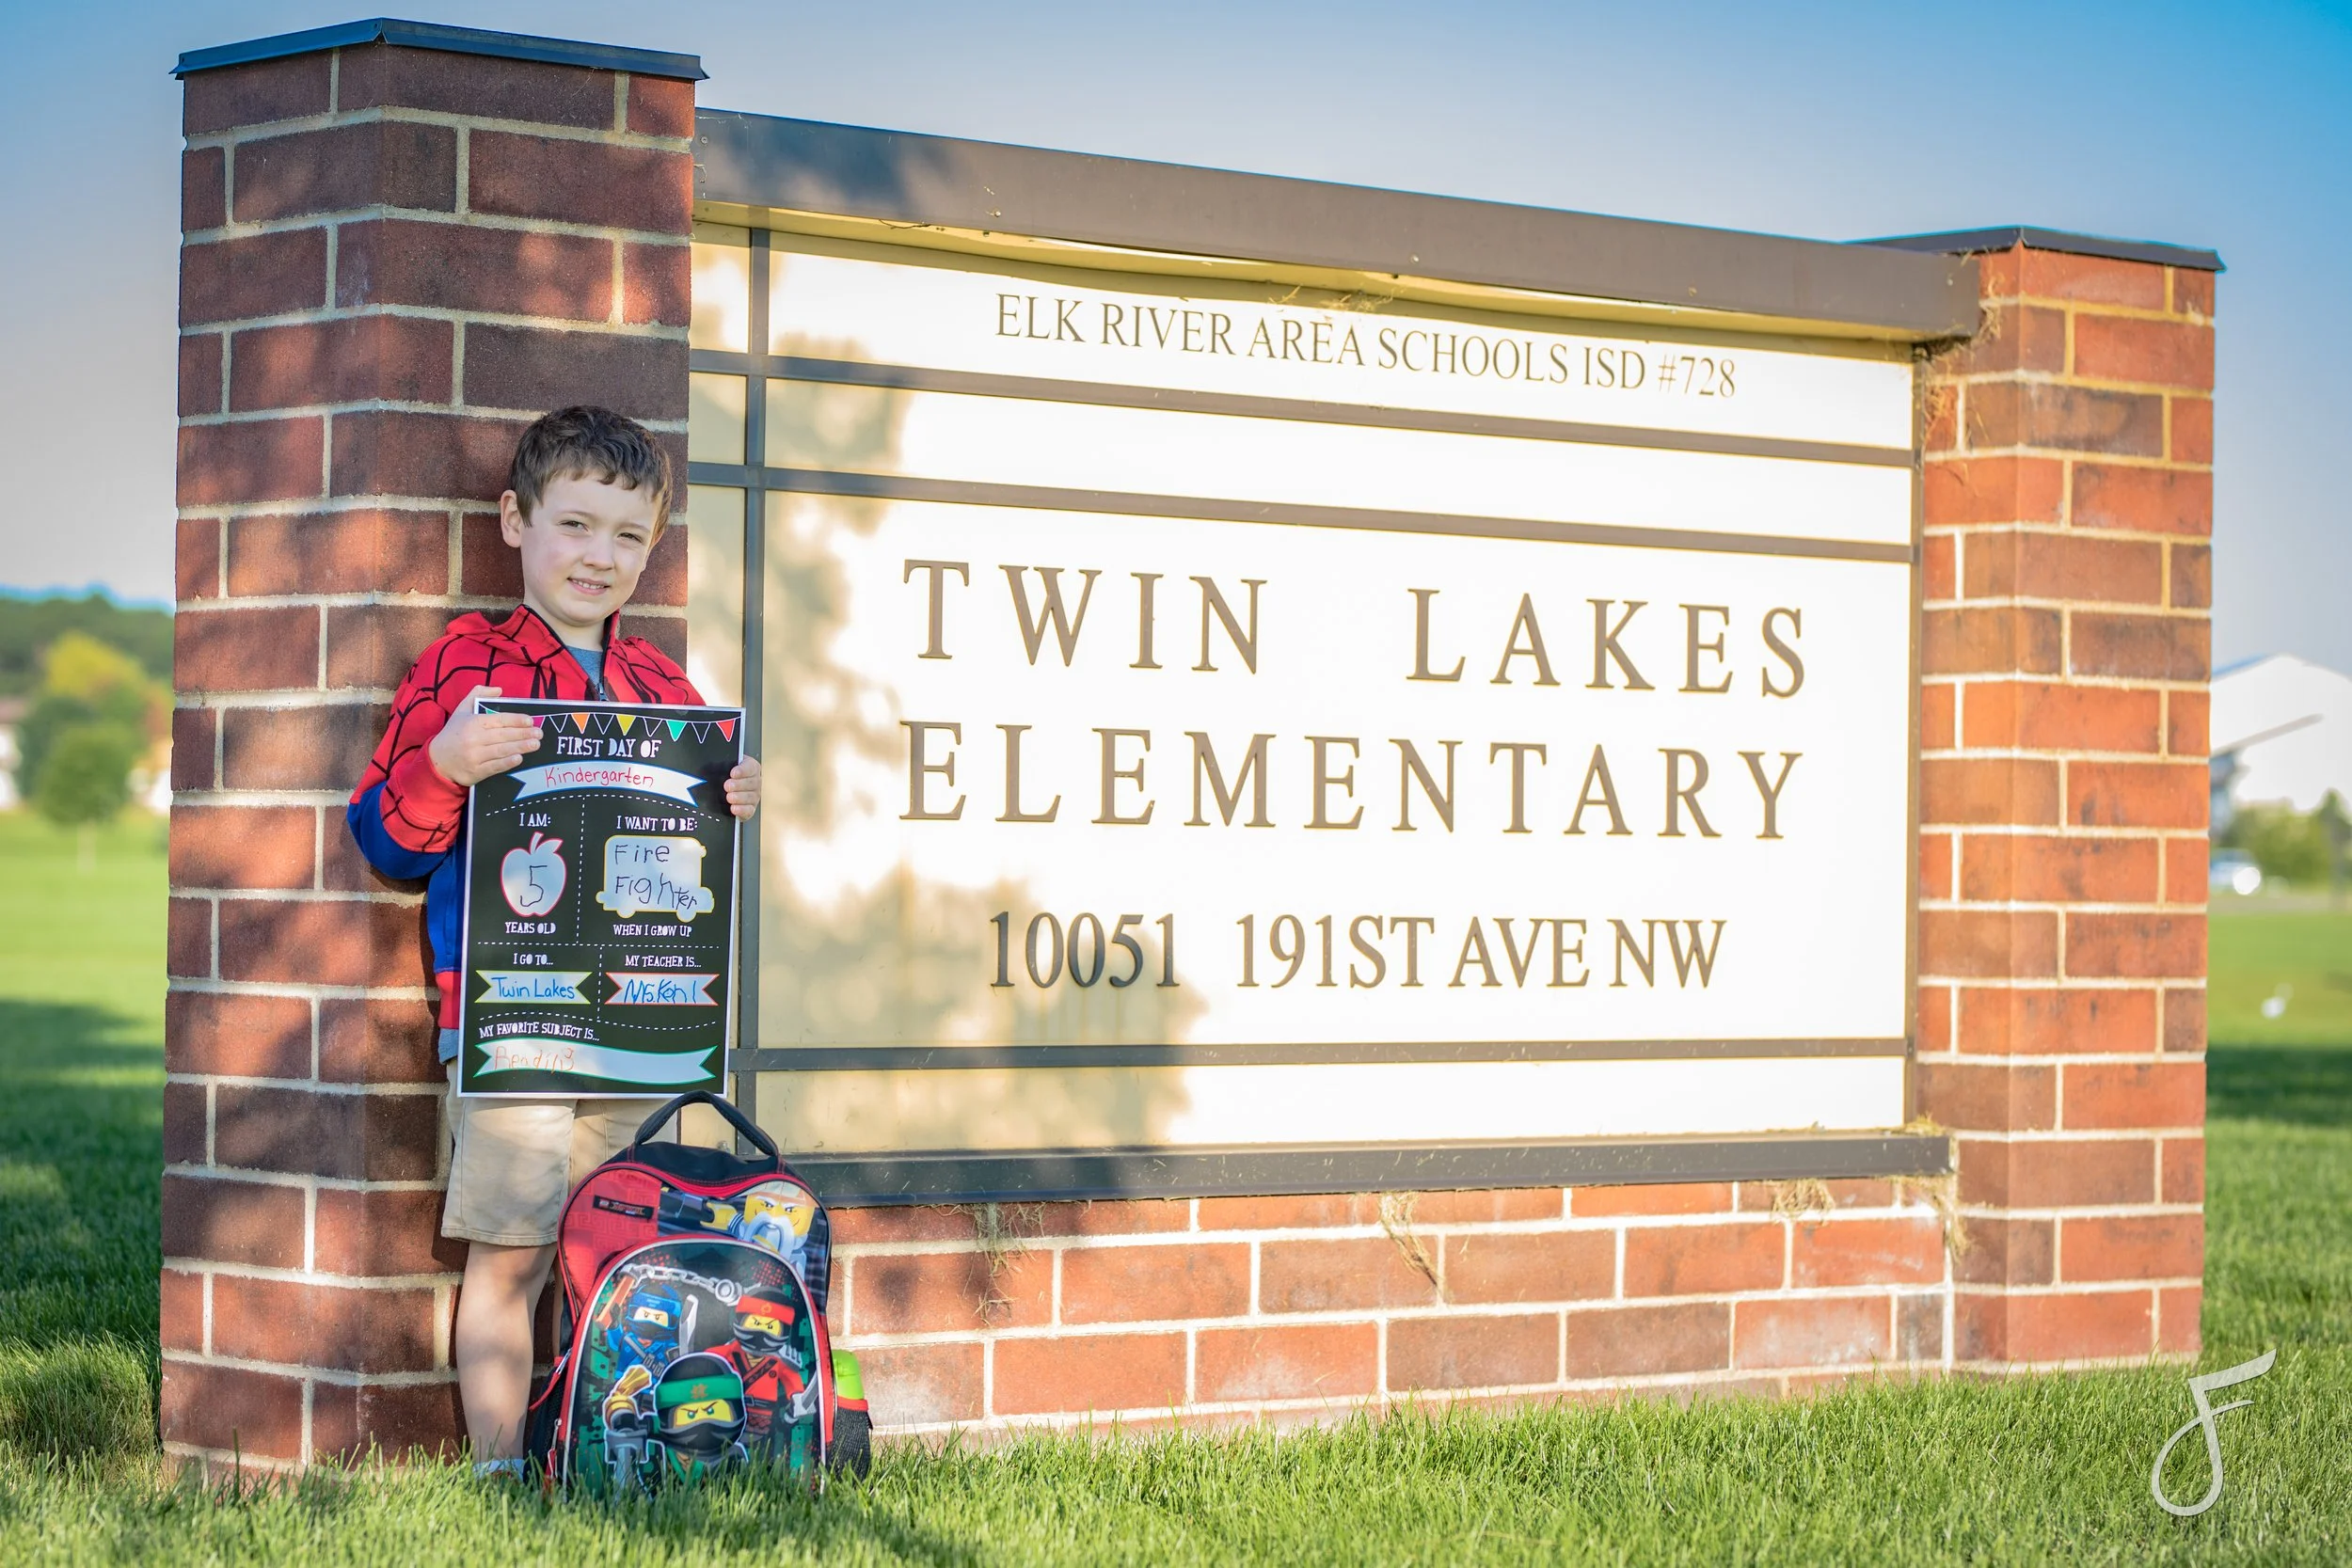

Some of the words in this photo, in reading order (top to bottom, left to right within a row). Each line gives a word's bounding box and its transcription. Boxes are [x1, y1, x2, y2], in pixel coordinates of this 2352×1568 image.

[994, 293, 1084, 342] ELK
[1100, 303, 1236, 356] RIVER
[1247, 315, 1366, 368] AREA
[1378, 327, 1569, 387] SCHOOLS
[1583, 346, 1645, 389] ISD
[1659, 355, 1737, 399] #728
[903, 558, 1268, 675] TWIN
[1406, 588, 1805, 700] LAKES
[556, 736, 603, 758] FIRST
[608, 737, 636, 758] DAY
[640, 739, 662, 758] OF
[545, 767, 654, 788] Kindergarten
[898, 720, 1804, 841] ELEMENTARY
[519, 813, 525, 827] I
[527, 813, 551, 828] AM:
[616, 816, 622, 830] I
[625, 816, 659, 832] WANT
[660, 817, 675, 832] TO
[678, 817, 698, 832] BE:
[614, 844, 670, 865] Fire
[519, 864, 548, 908] 5
[504, 922, 535, 934] YEARS
[537, 922, 557, 934] OLD
[612, 924, 642, 936] WHEN
[644, 925, 649, 936] I
[650, 925, 677, 937] GROW
[679, 926, 692, 937] UP
[513, 953, 518, 965] I
[519, 953, 533, 965] GO
[534, 954, 553, 966] TO...
[989, 911, 1181, 990] 10051
[1235, 912, 1435, 990] 191ST
[1448, 915, 1589, 990] AVE
[1606, 918, 1727, 990] NW
[625, 955, 640, 967] MY
[642, 955, 684, 968] TEACHER
[685, 956, 702, 968] IS...
[491, 976, 531, 998] Twin
[534, 978, 576, 1000] Lakes
[479, 1024, 494, 1038] MY
[496, 1022, 540, 1036] FAVORITE
[541, 1023, 582, 1038] SUBJECT
[583, 1027, 600, 1041] IS...
